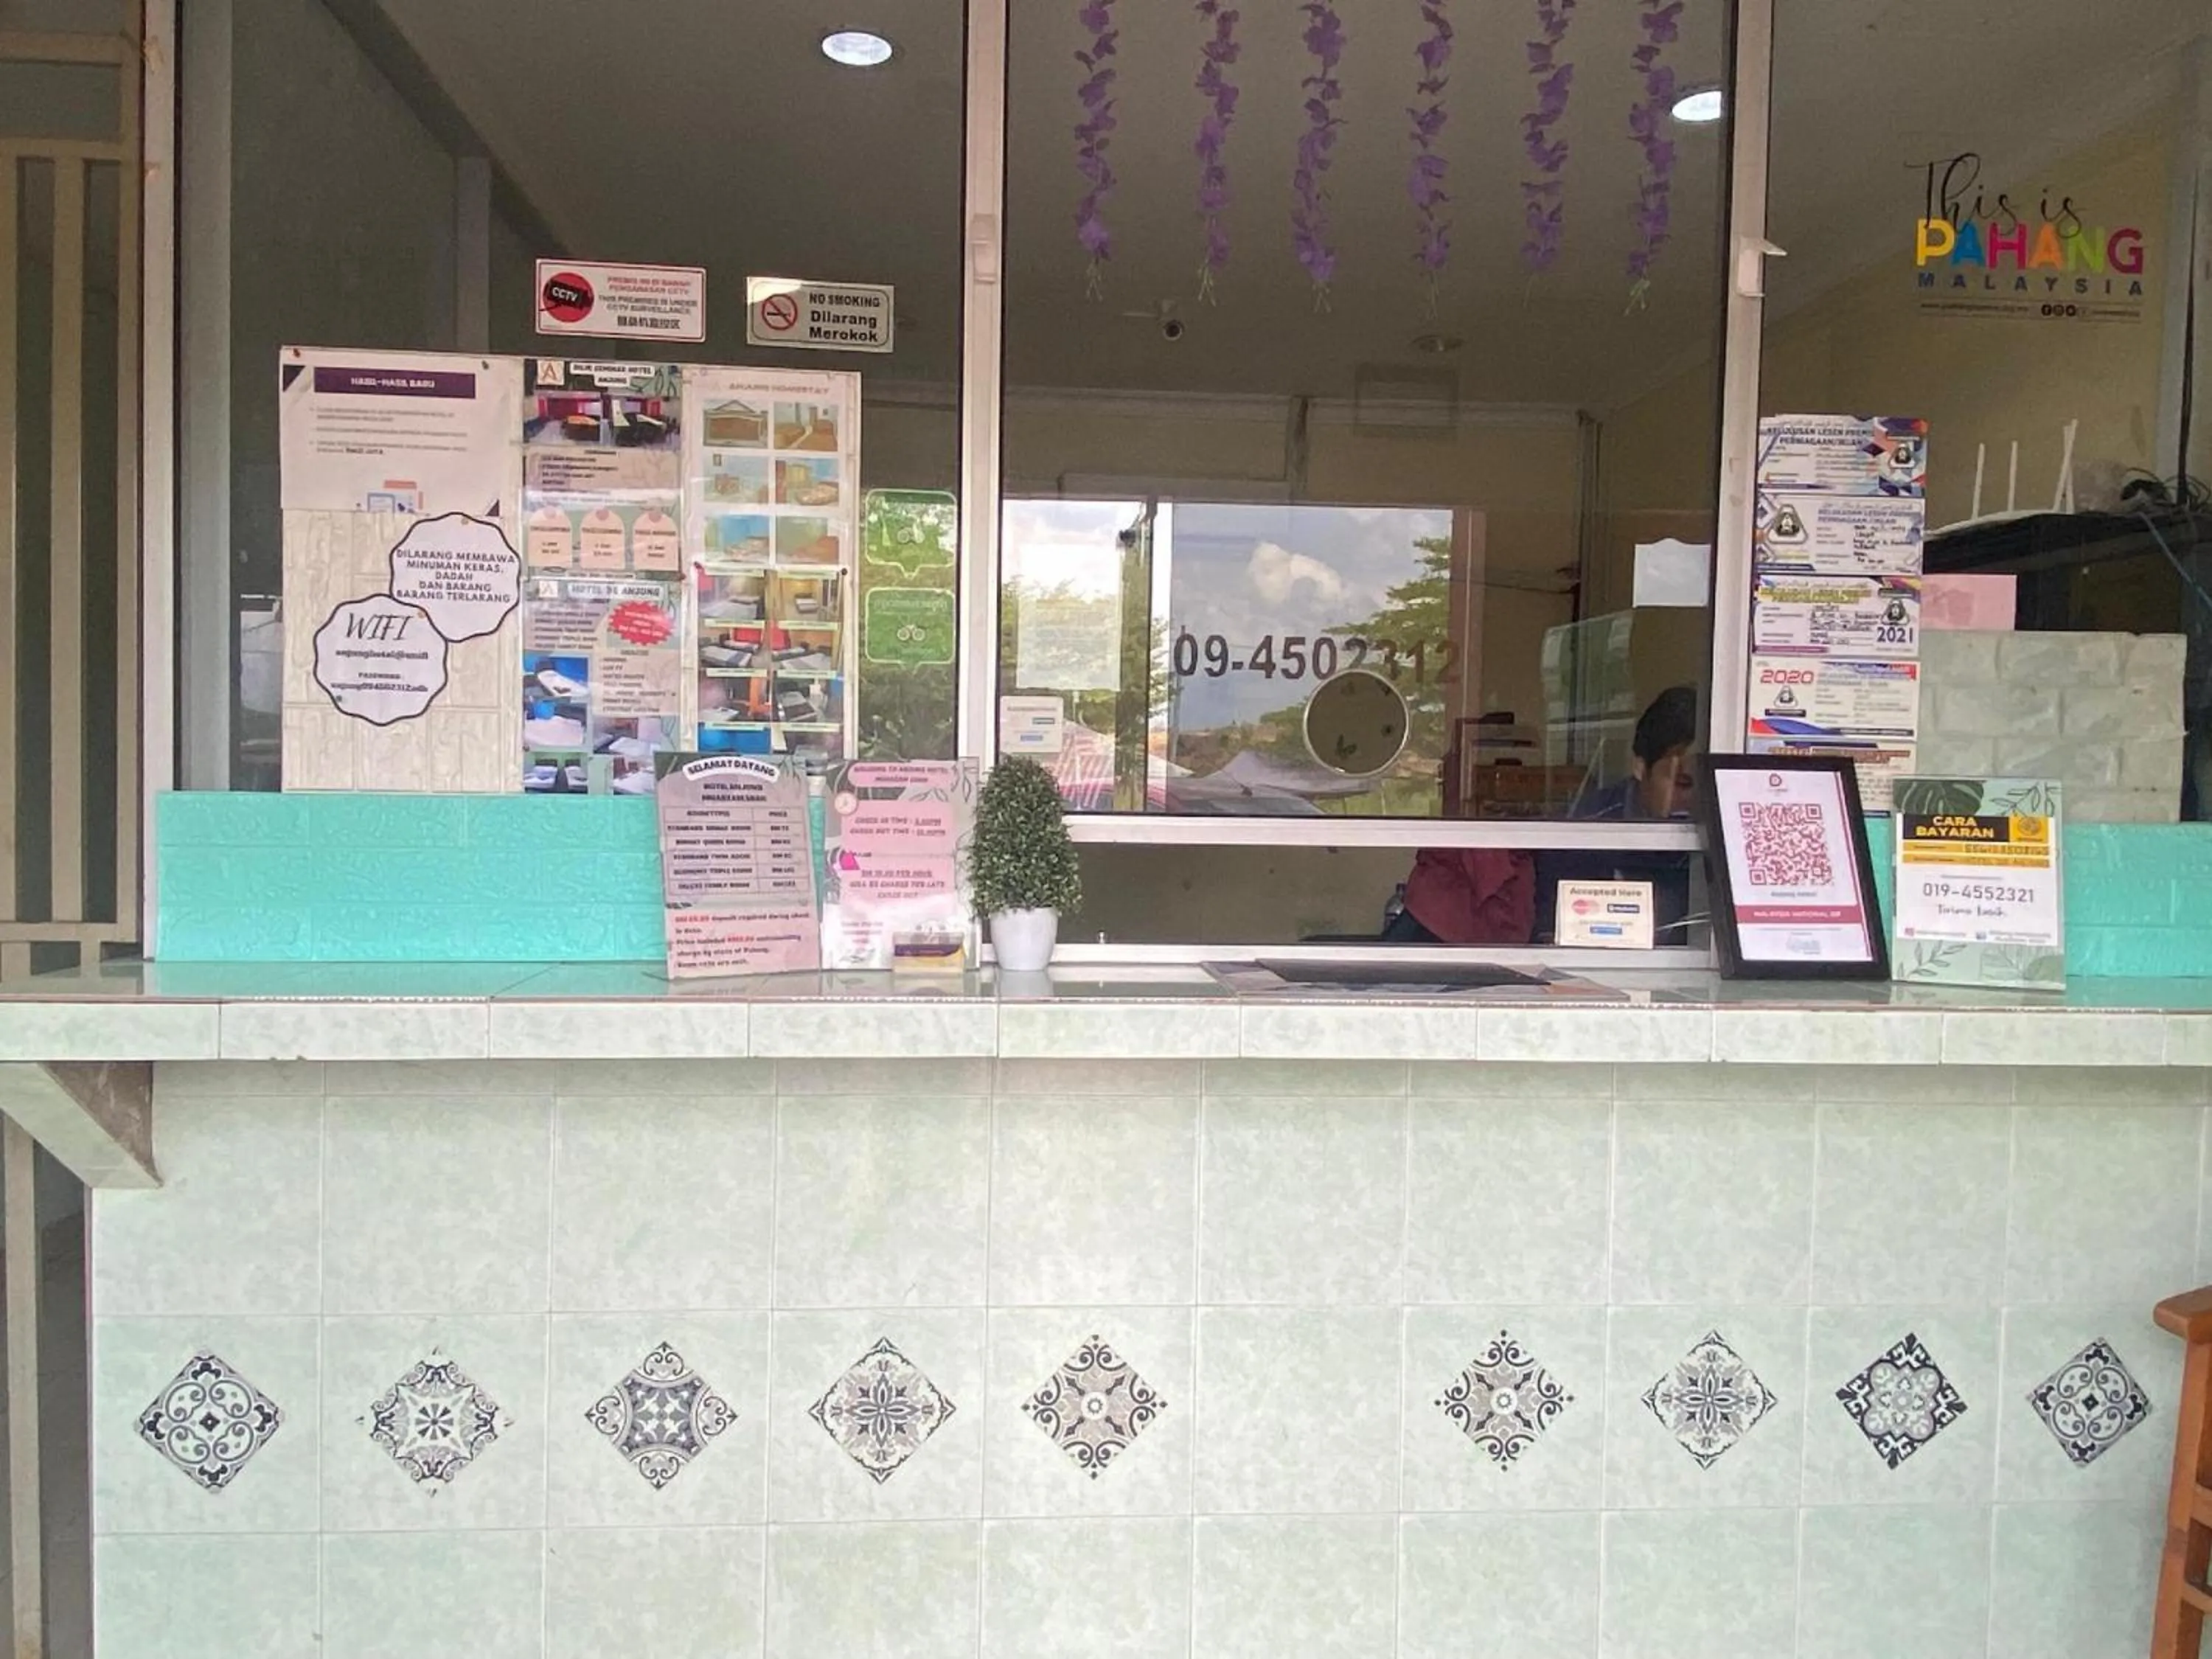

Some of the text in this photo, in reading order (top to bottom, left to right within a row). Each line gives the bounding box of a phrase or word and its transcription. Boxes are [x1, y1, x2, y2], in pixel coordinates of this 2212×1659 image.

[1904, 153, 2088, 239] This is
[1915, 218, 2144, 275] PAHANG
[1918, 272, 2143, 296] MALAYSIA
[552, 286, 579, 302] CCTV
[810, 293, 880, 308] NO SMOKING
[606, 303, 627, 311] CCTV
[811, 310, 877, 329] Dilarang
[810, 327, 878, 342] Merokok
[396, 549, 515, 563] DILARANG MEMBAWA
[407, 560, 461, 571] MINUMAN
[435, 572, 473, 580] DADAH
[419, 581, 491, 592] DAN BARANG
[396, 590, 511, 603] BARANG TERLARANG
[346, 613, 414, 641] WIFI
[1877, 627, 1914, 644] 2021
[1174, 633, 1460, 684] 09-4502312
[1760, 669, 1815, 684] 2020
[688, 760, 776, 776] SELAMAT DATANG
[1933, 816, 1978, 827] CARA
[1916, 827, 1994, 838] BAYARAN
[1570, 887, 1642, 897] Accepted Here
[1922, 883, 2035, 903] 019-4552321
